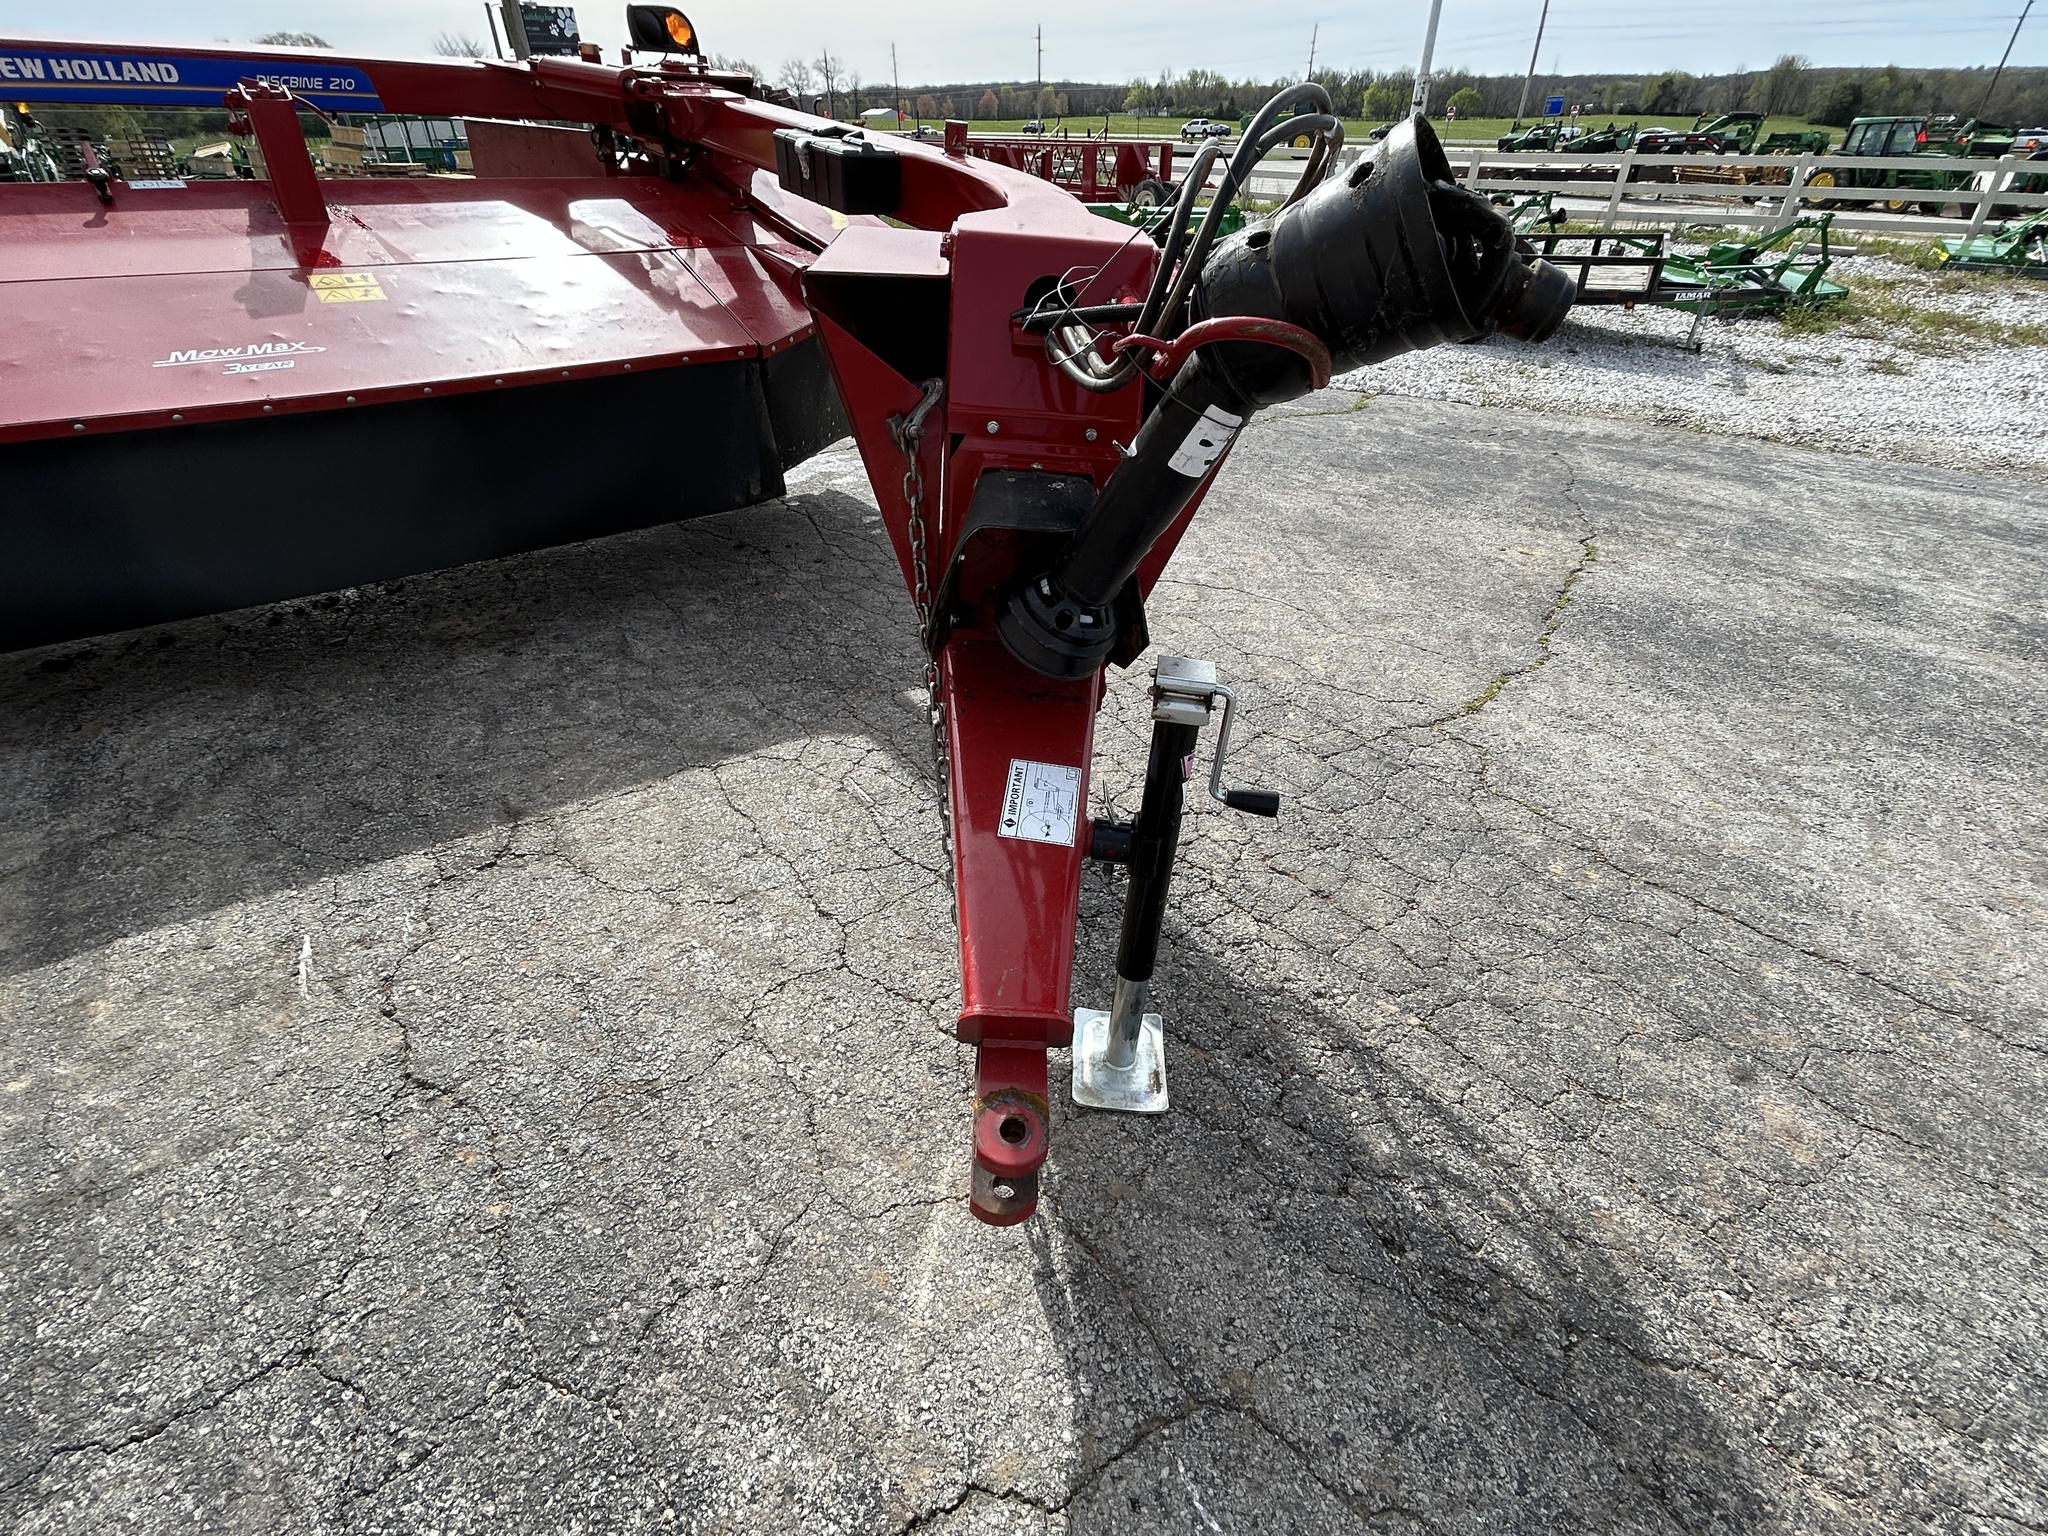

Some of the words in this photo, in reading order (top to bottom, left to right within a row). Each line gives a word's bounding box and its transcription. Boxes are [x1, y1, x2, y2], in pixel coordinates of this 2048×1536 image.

[0, 56, 45, 79] EW
[48, 58, 180, 84] HOLLAND
[256, 74, 323, 90] DISCBINE
[329, 77, 355, 90] 210
[1674, 291, 1712, 302] LAMAR
[168, 347, 243, 363] Mow
[246, 341, 306, 356] Max
[1007, 765, 1025, 816] IMPORTANT
